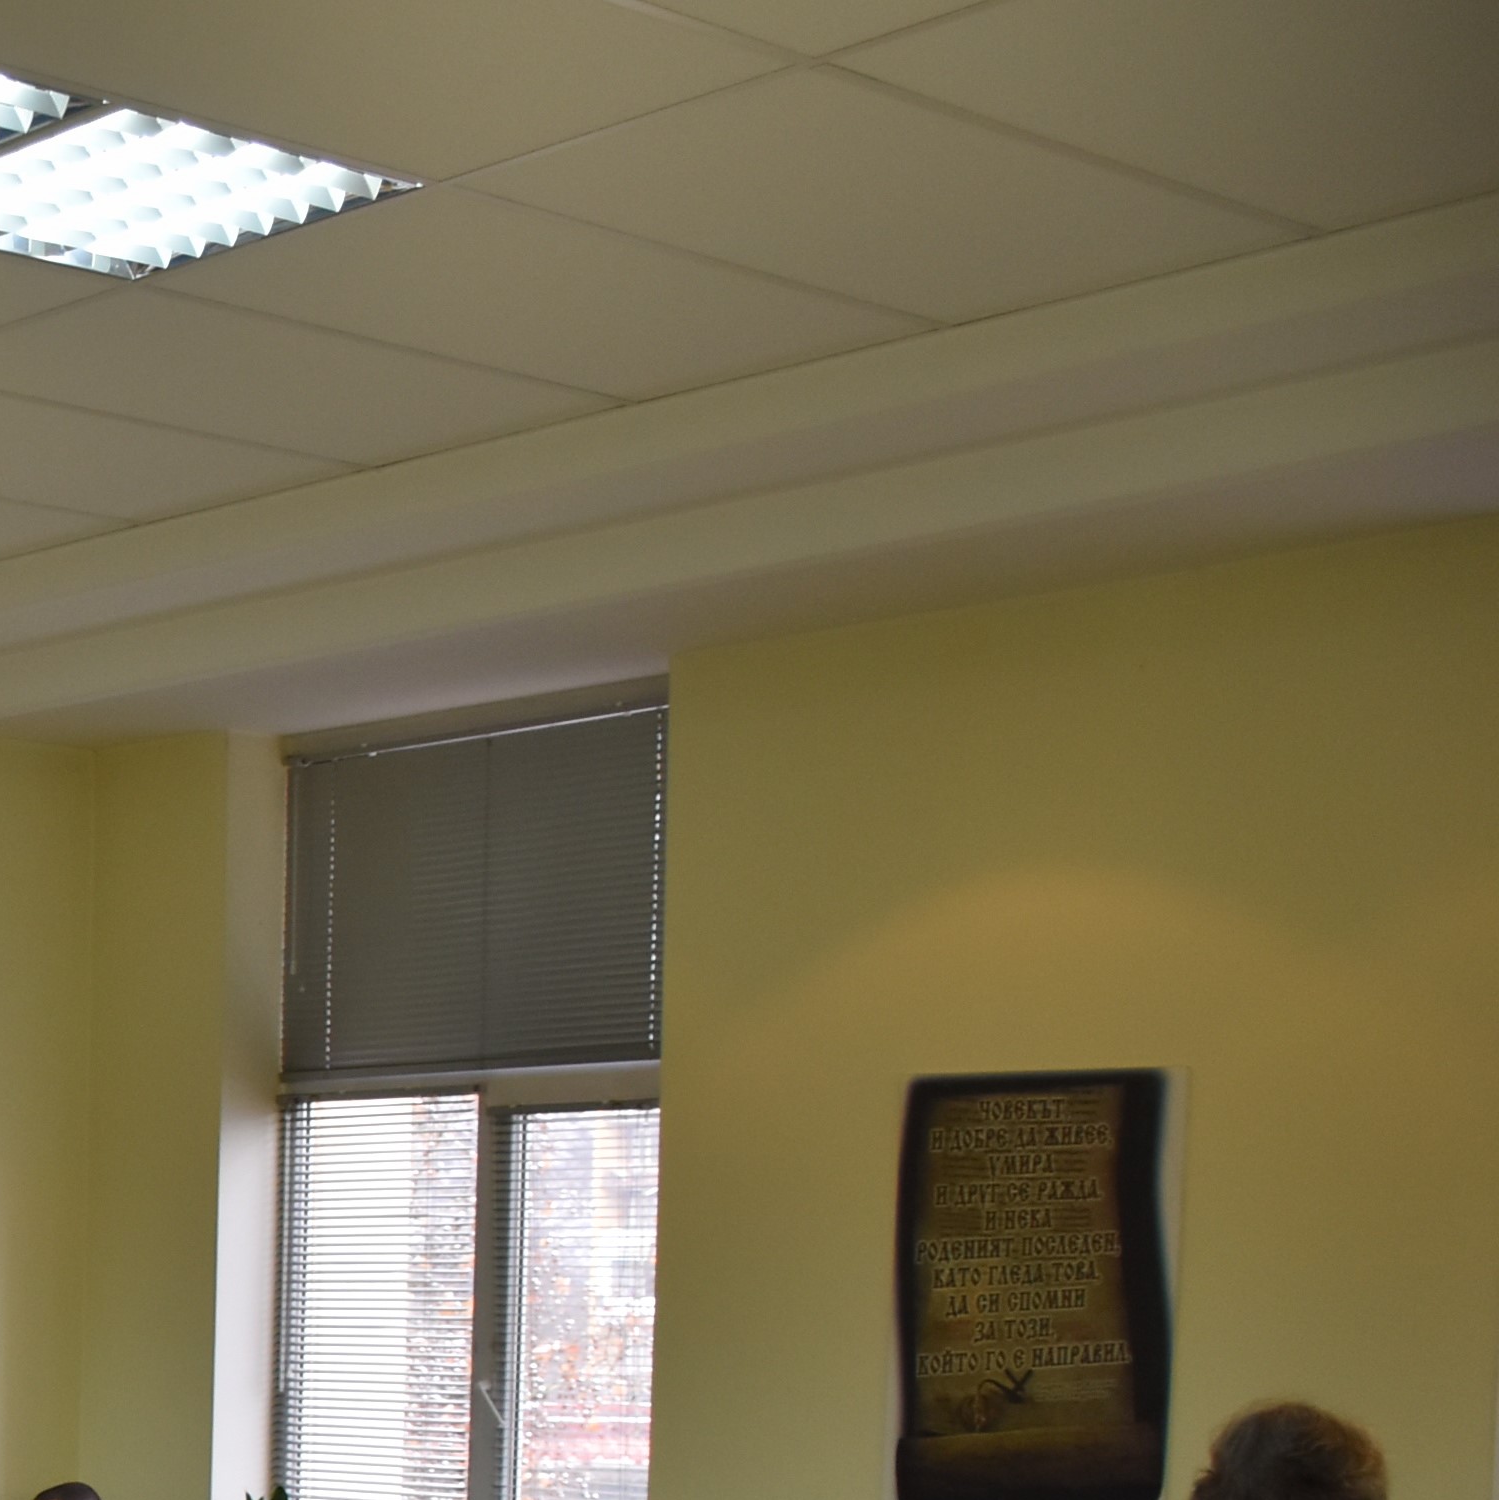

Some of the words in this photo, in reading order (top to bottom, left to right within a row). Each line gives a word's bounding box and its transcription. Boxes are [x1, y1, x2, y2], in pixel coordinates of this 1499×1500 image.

[931, 1131, 944, 1151] И
[950, 1130, 1009, 1151] ДОБРЕ
[1015, 1130, 1037, 1150] ДА
[989, 1156, 1055, 1178] УМИРА
[936, 1186, 949, 1206] И
[955, 1185, 1000, 1208] ДРУГ
[1007, 1183, 1032, 1202] СЕ
[985, 1212, 997, 1231] И
[1004, 1209, 1053, 1230] НЕКА
[934, 1268, 982, 1289] КАТО
[989, 1266, 1045, 1286] ГЛЕДА
[946, 1296, 970, 1318] ДА
[976, 1294, 1000, 1315] СИ
[1007, 1290, 1087, 1313] СПОМНИ
[974, 1322, 996, 1344] ЗА
[917, 1349, 980, 1376] КОЙТО
[986, 1350, 1007, 1371] ГО
[1014, 1350, 1026, 1367] Е
